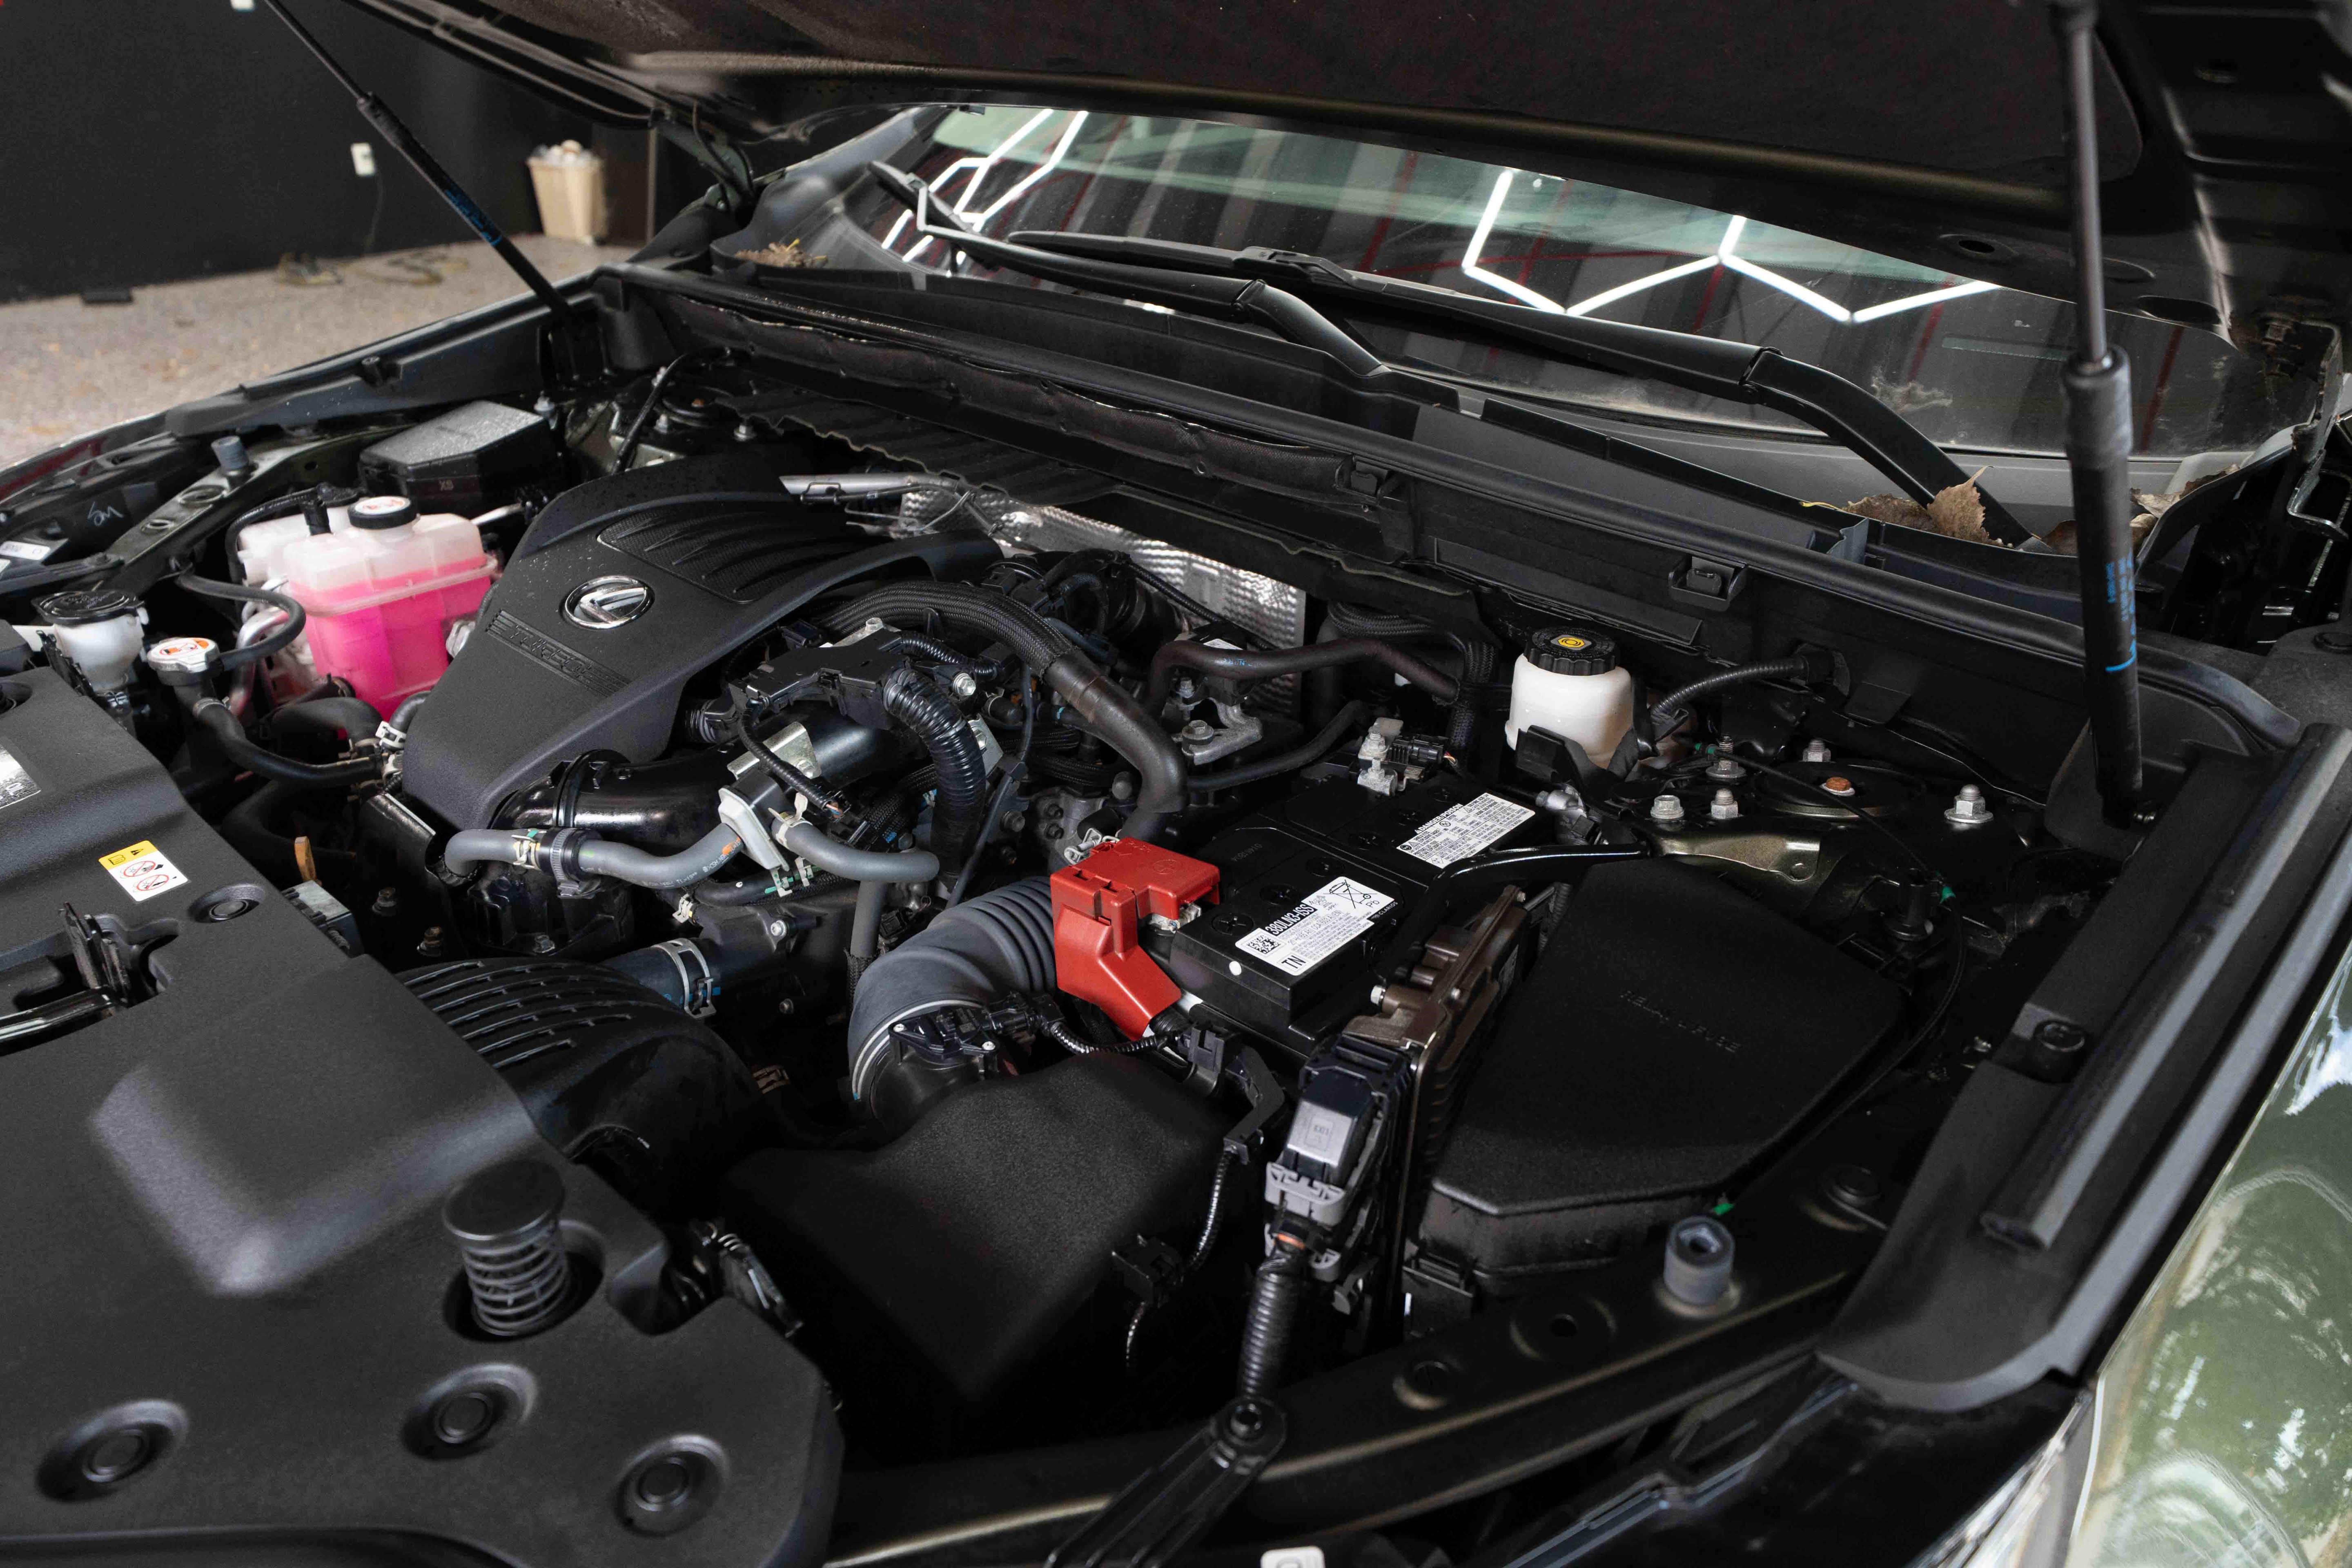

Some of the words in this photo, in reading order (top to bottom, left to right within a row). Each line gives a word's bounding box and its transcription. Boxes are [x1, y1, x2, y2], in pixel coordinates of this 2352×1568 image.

[1418, 803, 1463, 831] DANGER/POISON
[1378, 902, 1398, 915] CLARIOS
[1265, 904, 1314, 935] 380LN3-ISS
[1282, 955, 1307, 969] TN
